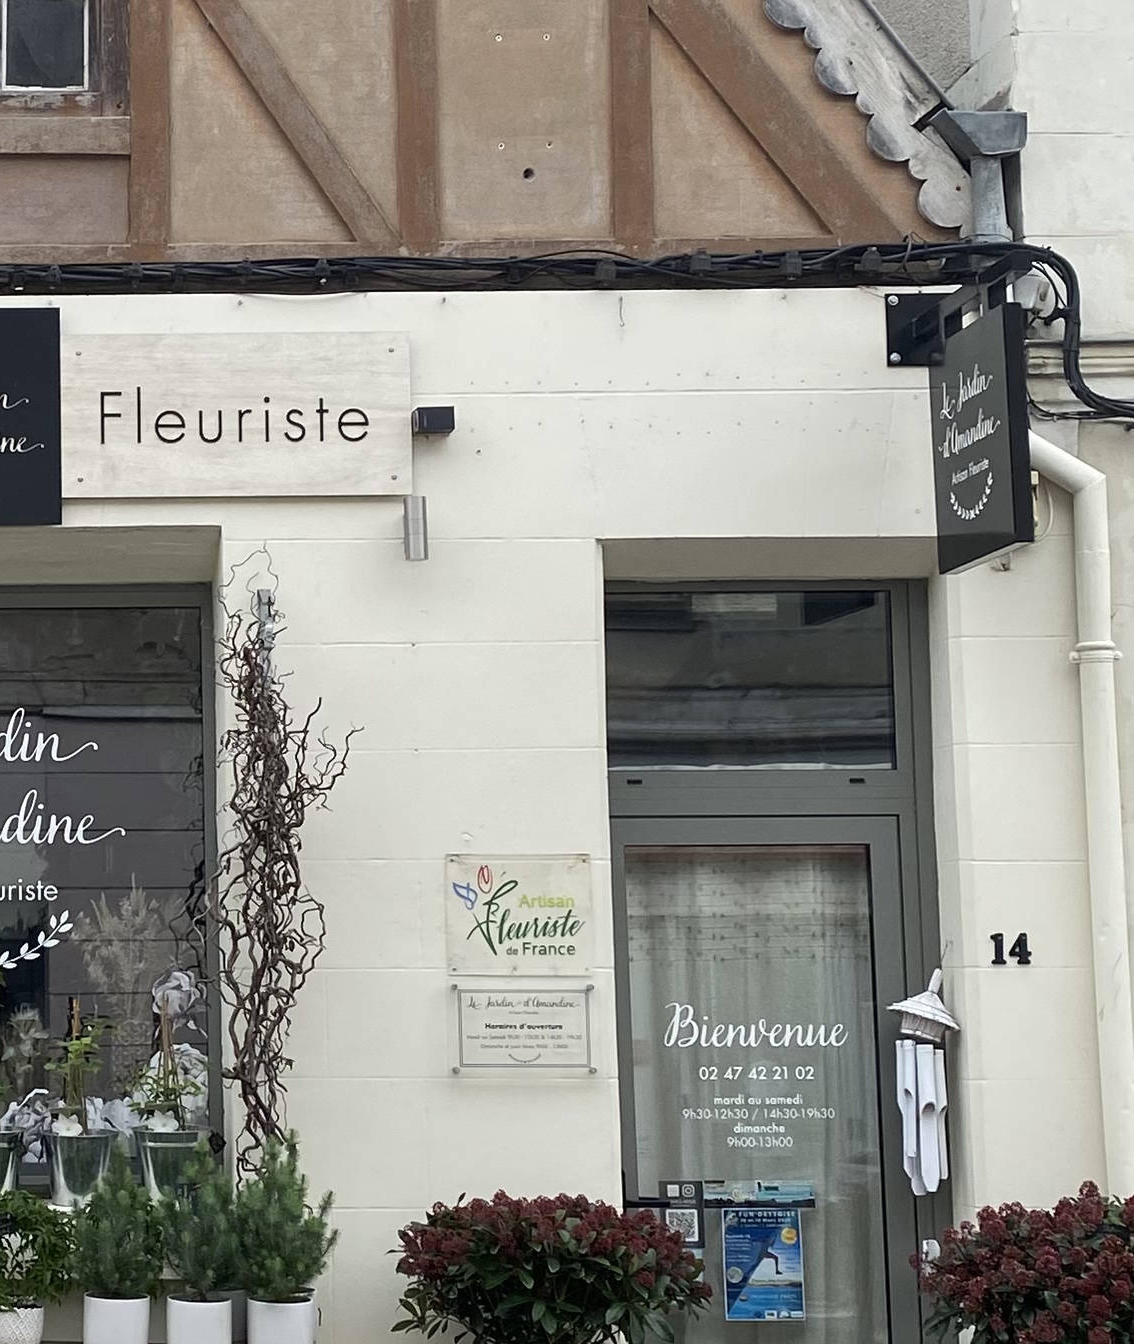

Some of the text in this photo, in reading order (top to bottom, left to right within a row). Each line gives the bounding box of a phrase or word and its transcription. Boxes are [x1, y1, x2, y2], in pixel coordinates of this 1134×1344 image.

[940, 363, 993, 420] Le Jardin
[99, 387, 371, 444] Fleuriste
[938, 408, 1001, 458] d'Amandine
[518, 894, 575, 909] Artisan
[467, 879, 585, 956] Fleuriste
[506, 942, 576, 956] de France
[990, 932, 1032, 965] 14
[485, 996, 523, 1010] Jardin
[664, 1003, 848, 1047] Bienvenue
[699, 1066, 815, 1080] 02 47 42 21 02
[714, 1094, 803, 1105] mardi au samedi
[682, 1108, 749, 1119] 9h30-12h30
[733, 1123, 785, 1133] dimanche
[727, 1136, 793, 1148] 9h00-13h00
